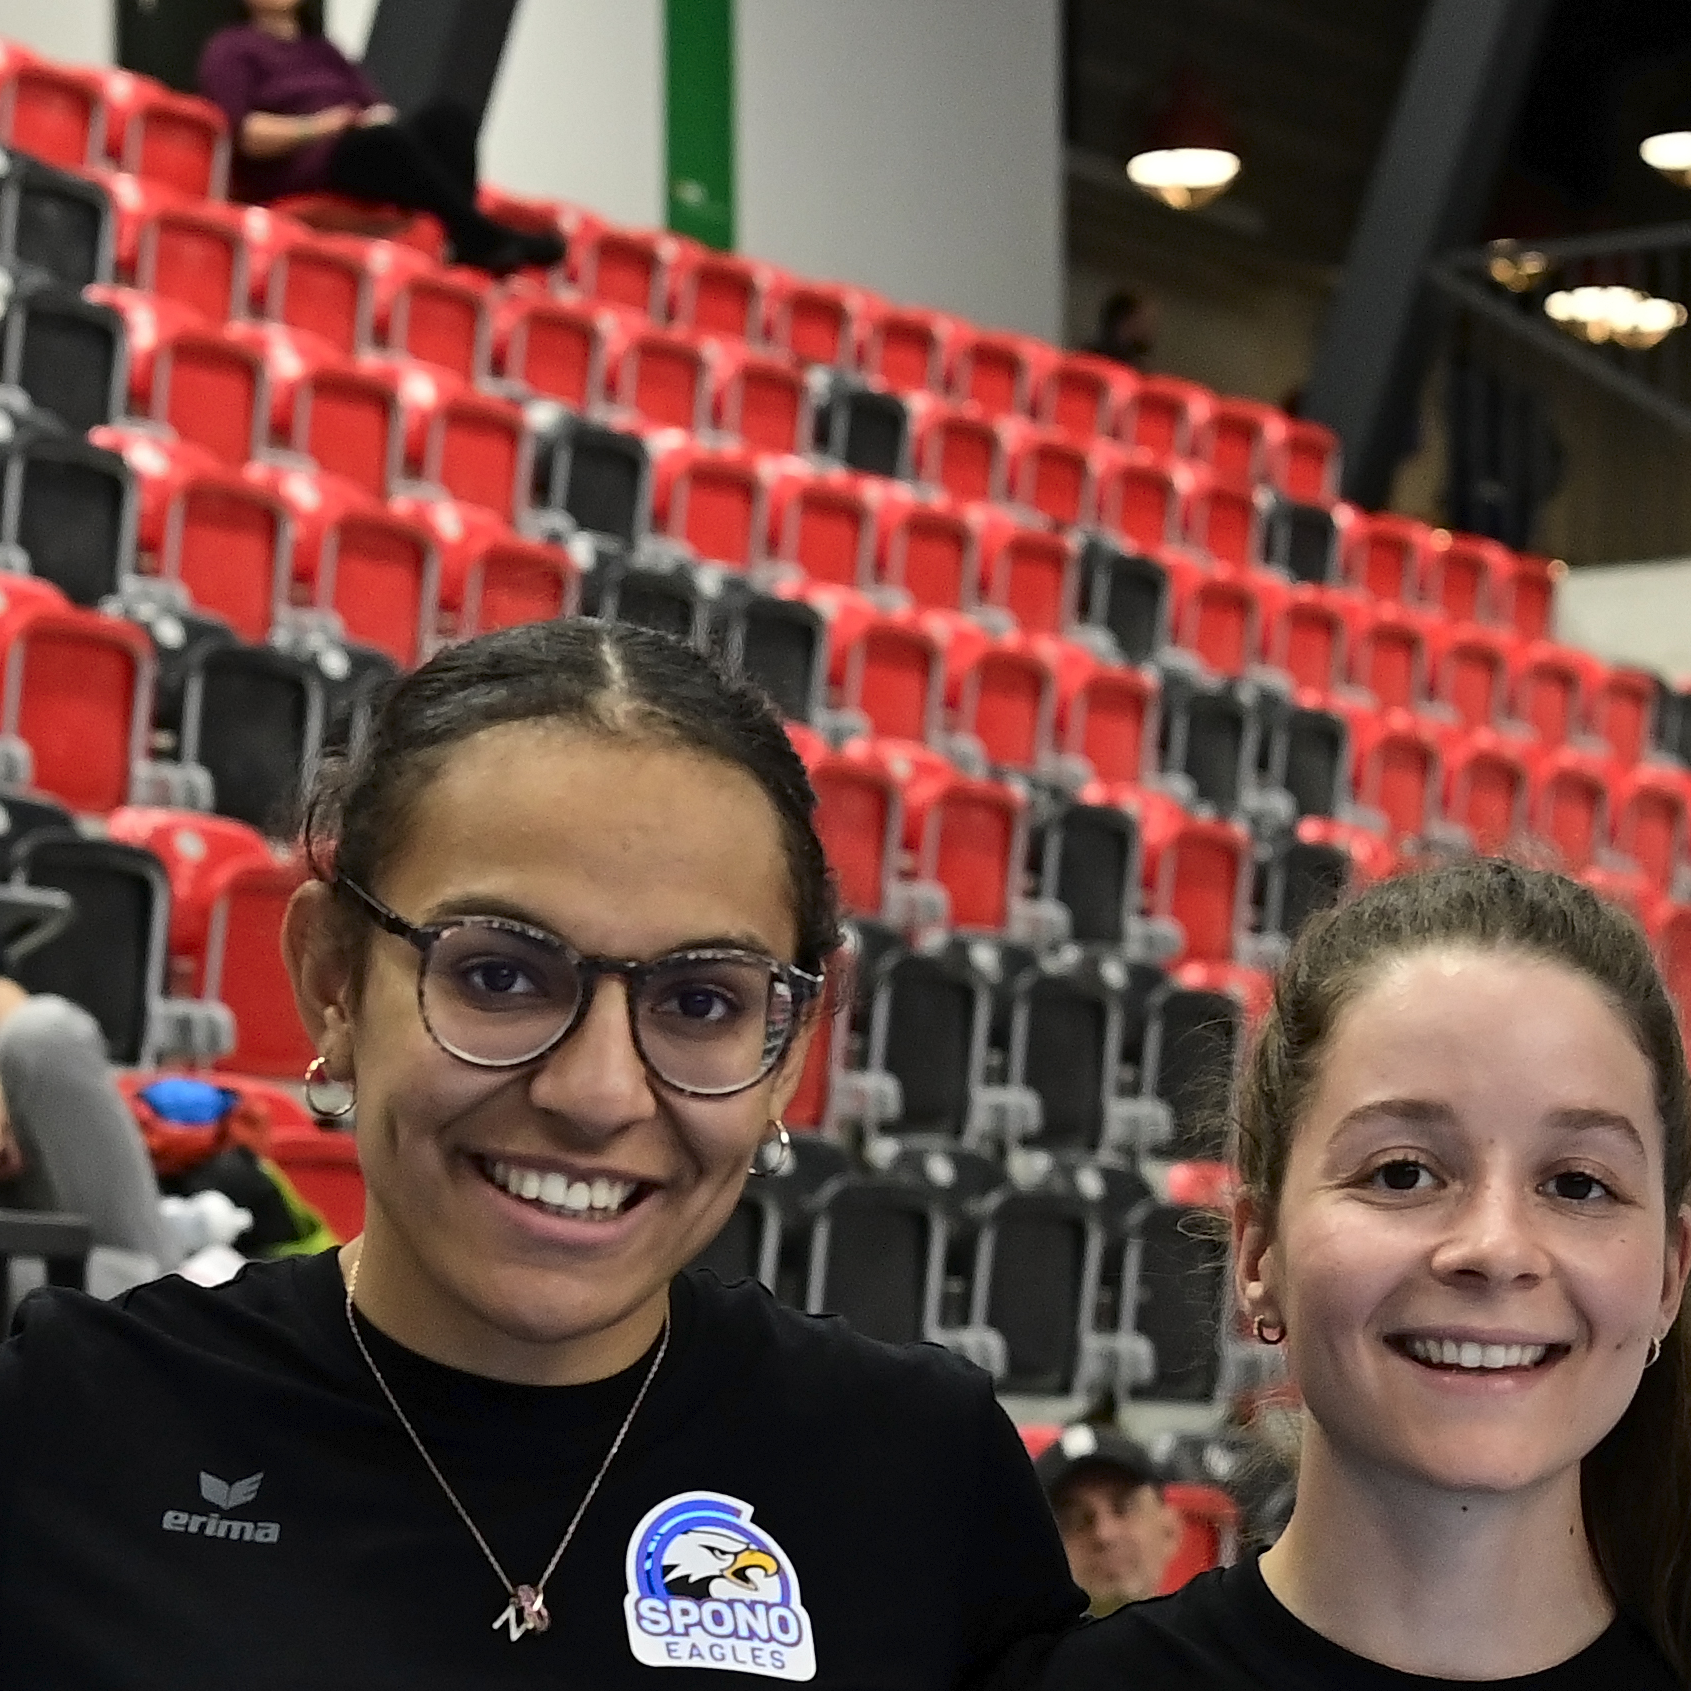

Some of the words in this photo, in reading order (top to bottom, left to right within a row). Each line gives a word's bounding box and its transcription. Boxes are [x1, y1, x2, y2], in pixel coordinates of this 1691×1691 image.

[162, 1510, 281, 1544] erima
[636, 1597, 802, 1647] SPONO
[666, 1641, 786, 1670] EAGLES
